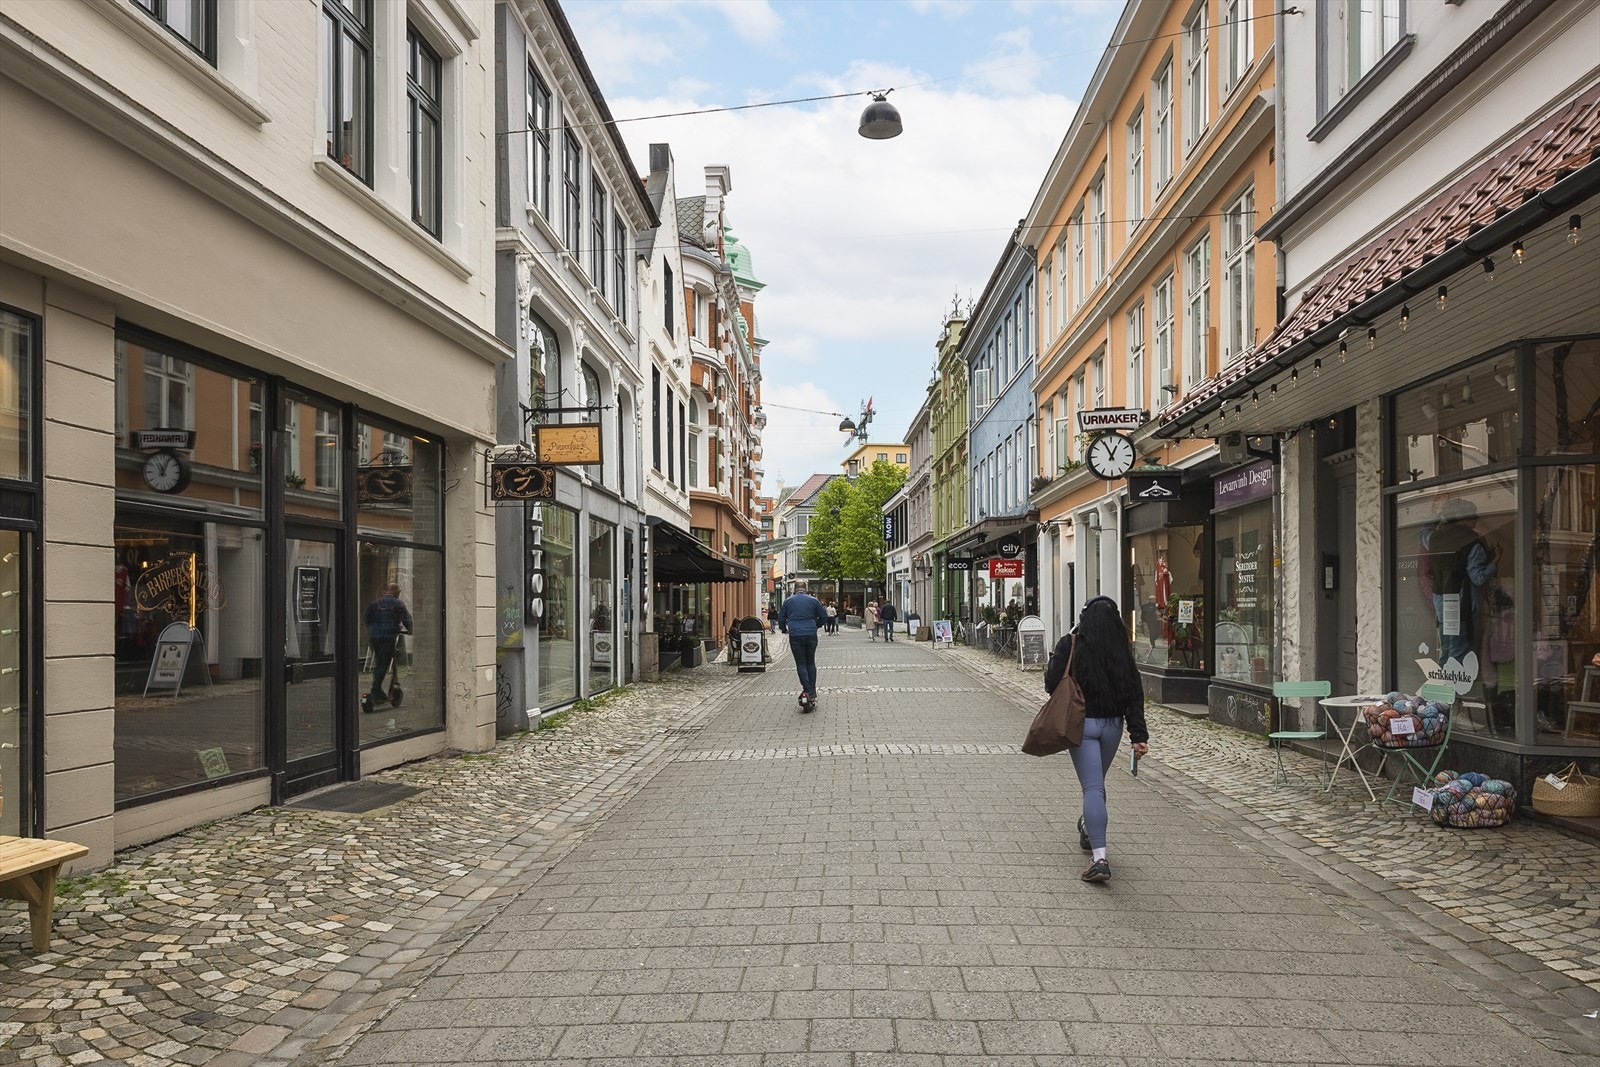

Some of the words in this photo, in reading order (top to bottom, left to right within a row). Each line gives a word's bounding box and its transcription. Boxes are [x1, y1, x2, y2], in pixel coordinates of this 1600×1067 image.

[1082, 413, 1138, 425] URMAKER
[1002, 543, 1019, 554] city
[531, 501, 543, 618] ATTOO
[1427, 669, 1472, 685] strikkelykke
